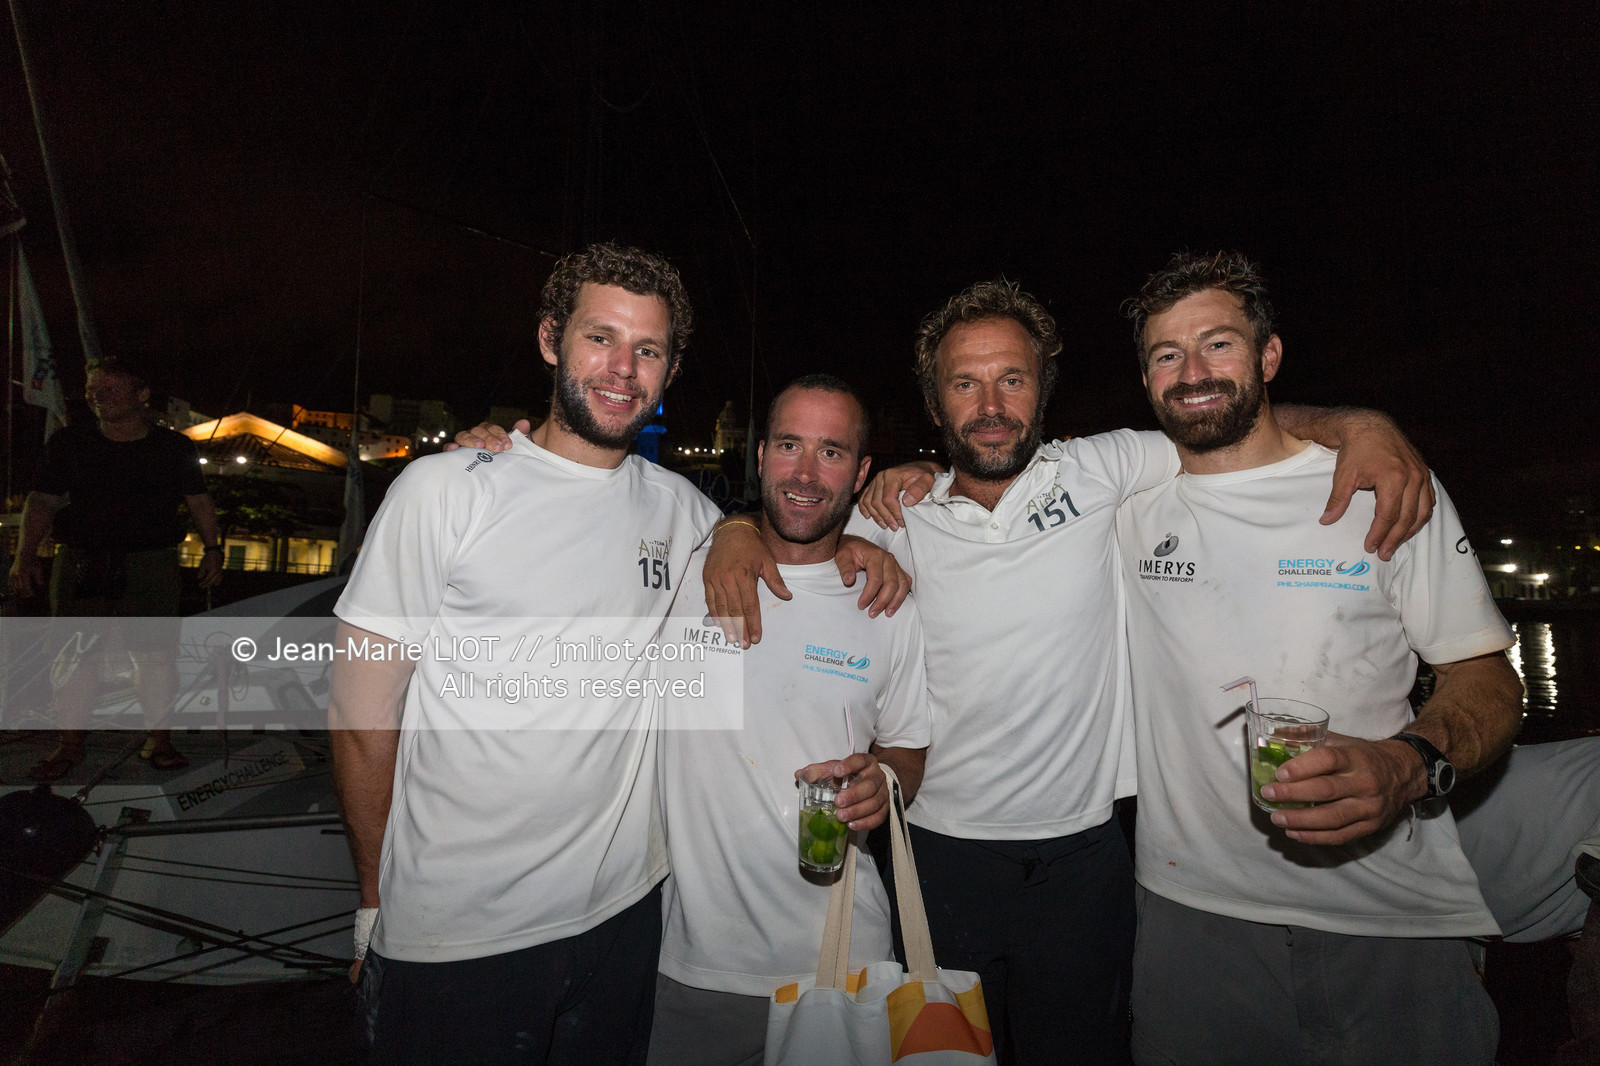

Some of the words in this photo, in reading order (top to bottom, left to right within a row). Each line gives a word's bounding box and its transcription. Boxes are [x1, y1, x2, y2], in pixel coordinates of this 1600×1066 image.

[1027, 490, 1081, 532] 151
[1139, 559, 1195, 575] IMERYS
[1278, 559, 1335, 568] ENERGY
[638, 557, 671, 591] 151
[683, 627, 741, 648] IMER
[715, 647, 741, 655] PERFORM
[805, 644, 848, 660] ENERGY
[804, 653, 845, 667] CHALLENGE
